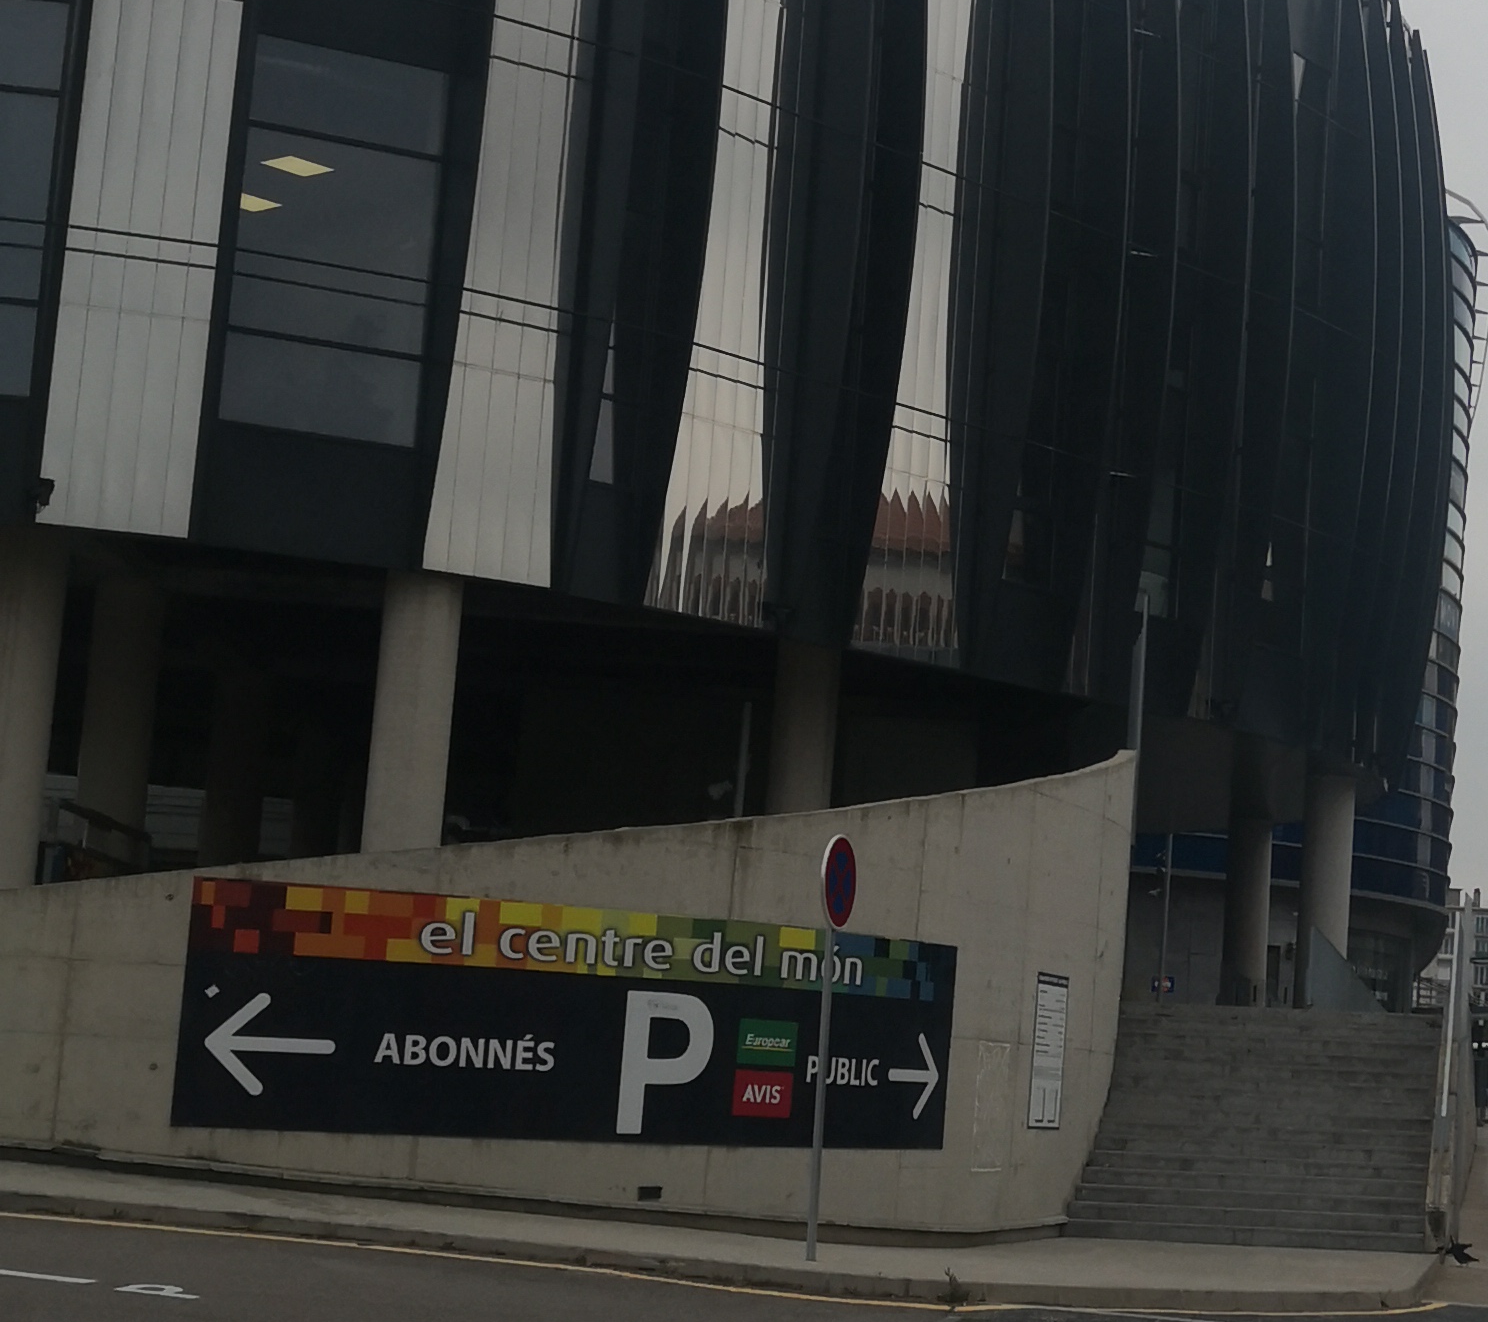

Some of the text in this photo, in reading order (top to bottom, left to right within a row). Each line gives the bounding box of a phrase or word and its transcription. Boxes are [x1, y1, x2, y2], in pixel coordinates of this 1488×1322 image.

[420, 912, 476, 957] el
[500, 927, 674, 970] centre
[692, 931, 765, 977] del
[373, 1032, 556, 1072] ABONNÉS
[745, 1033, 791, 1049] Europcar
[615, 989, 715, 1135] P
[742, 1084, 781, 1104] AVIS
